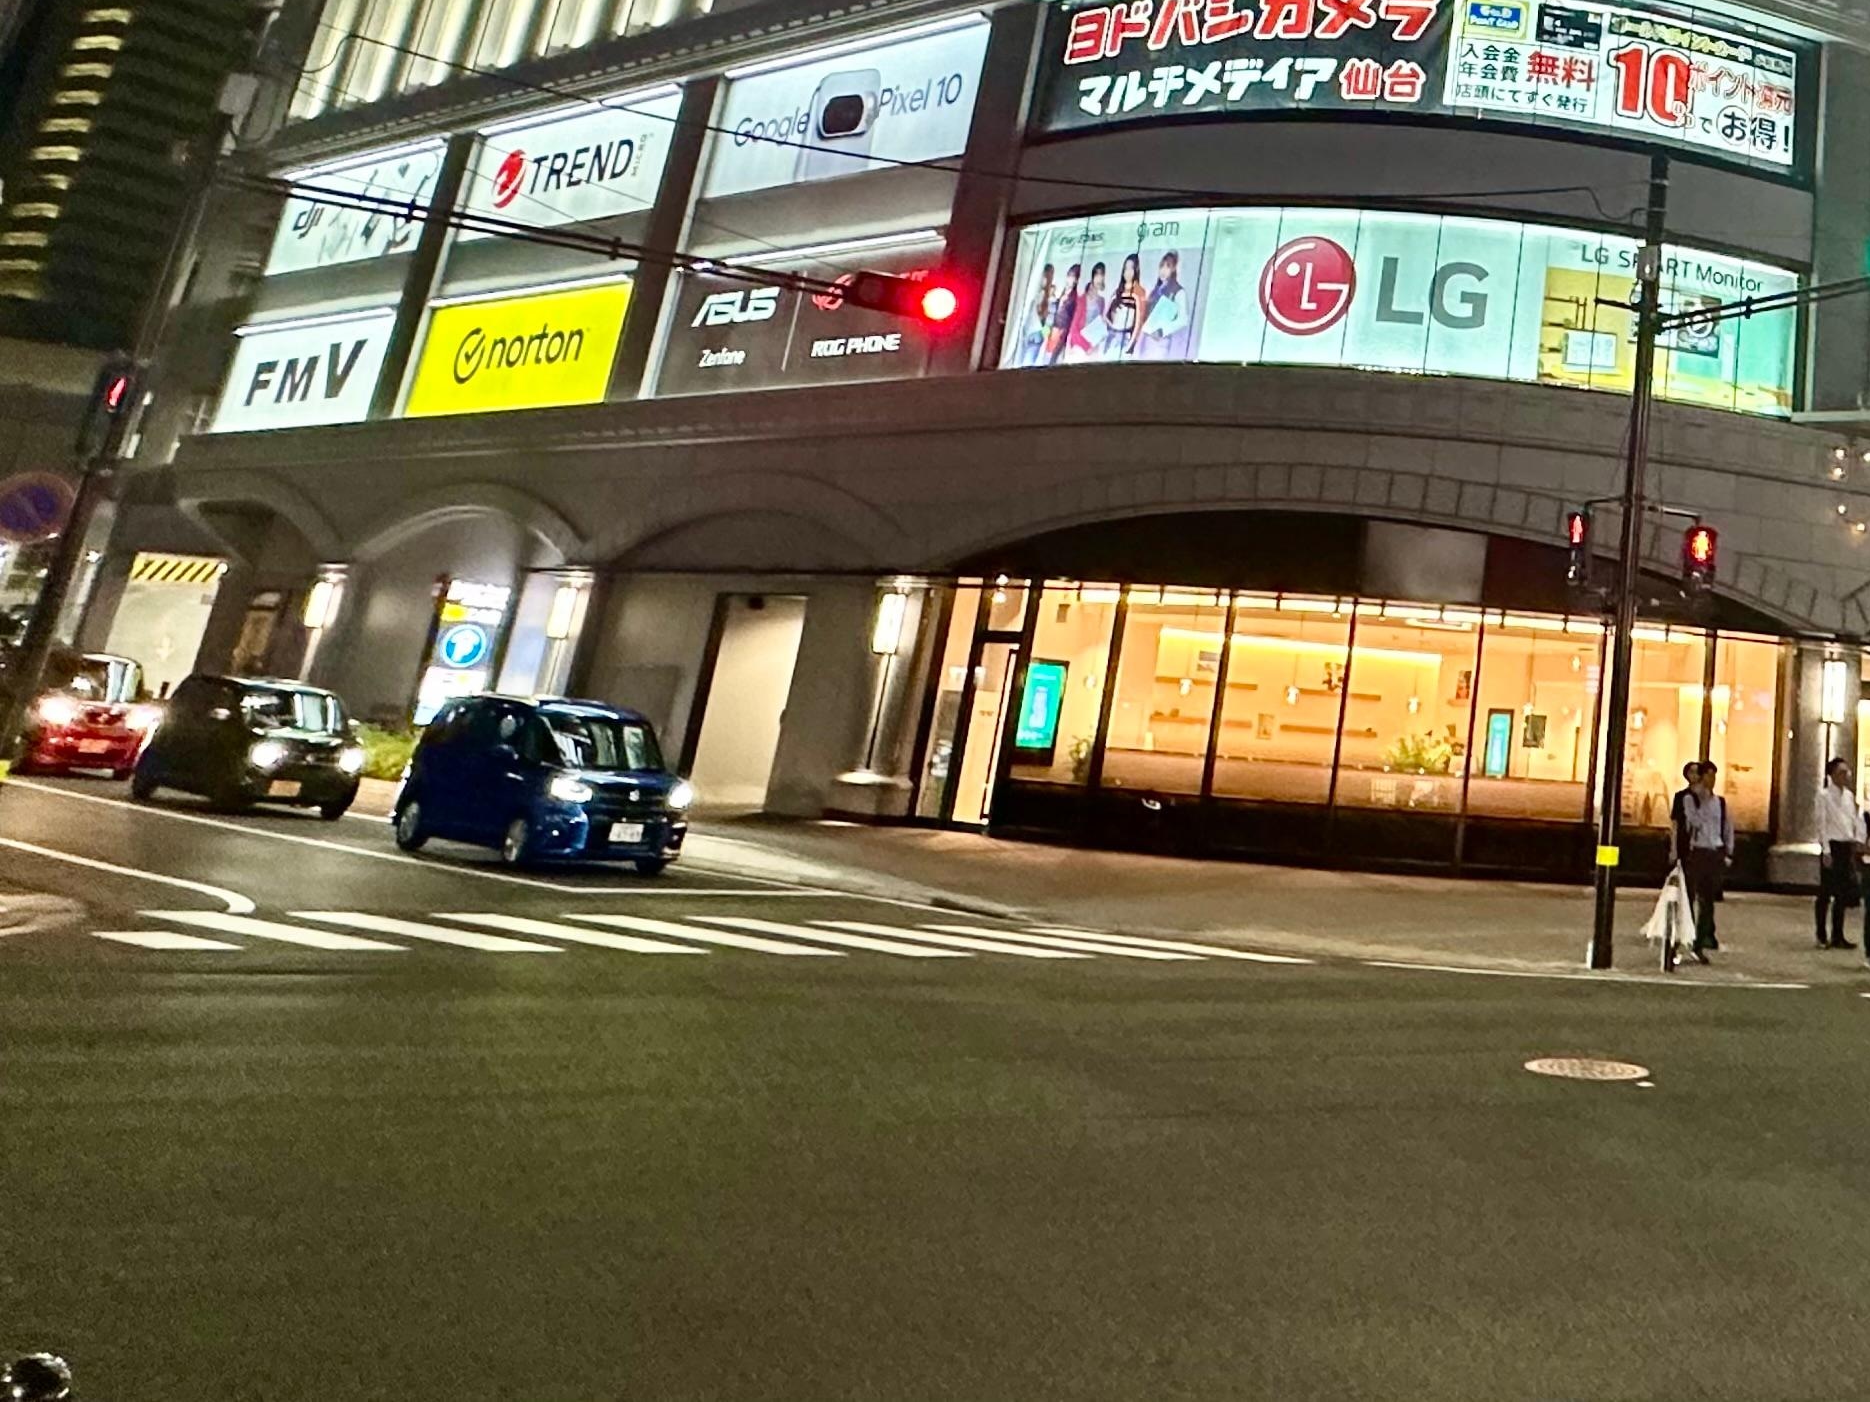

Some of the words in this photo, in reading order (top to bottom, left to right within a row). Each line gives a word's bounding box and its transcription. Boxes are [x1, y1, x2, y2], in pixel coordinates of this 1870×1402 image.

[1460, 61, 1519, 82] 年会費
[1461, 43, 1520, 64] 入会金
[1526, 50, 1595, 92] 無料
[734, 107, 810, 147] Google
[880, 80, 931, 116] Pixel
[937, 73, 963, 105] 10
[1456, 83, 1588, 113] 店頭にてすぐ発行
[529, 139, 634, 195] TREND
[1581, 244, 1609, 265] LG
[1696, 263, 1764, 292] Monitor
[691, 286, 780, 327] ASUS
[1376, 255, 1489, 330] LG
[487, 328, 584, 368] norton
[699, 348, 746, 368] Zenfone
[811, 338, 846, 358] ROG
[847, 333, 902, 355] PHONE
[243, 338, 369, 406] FMV
